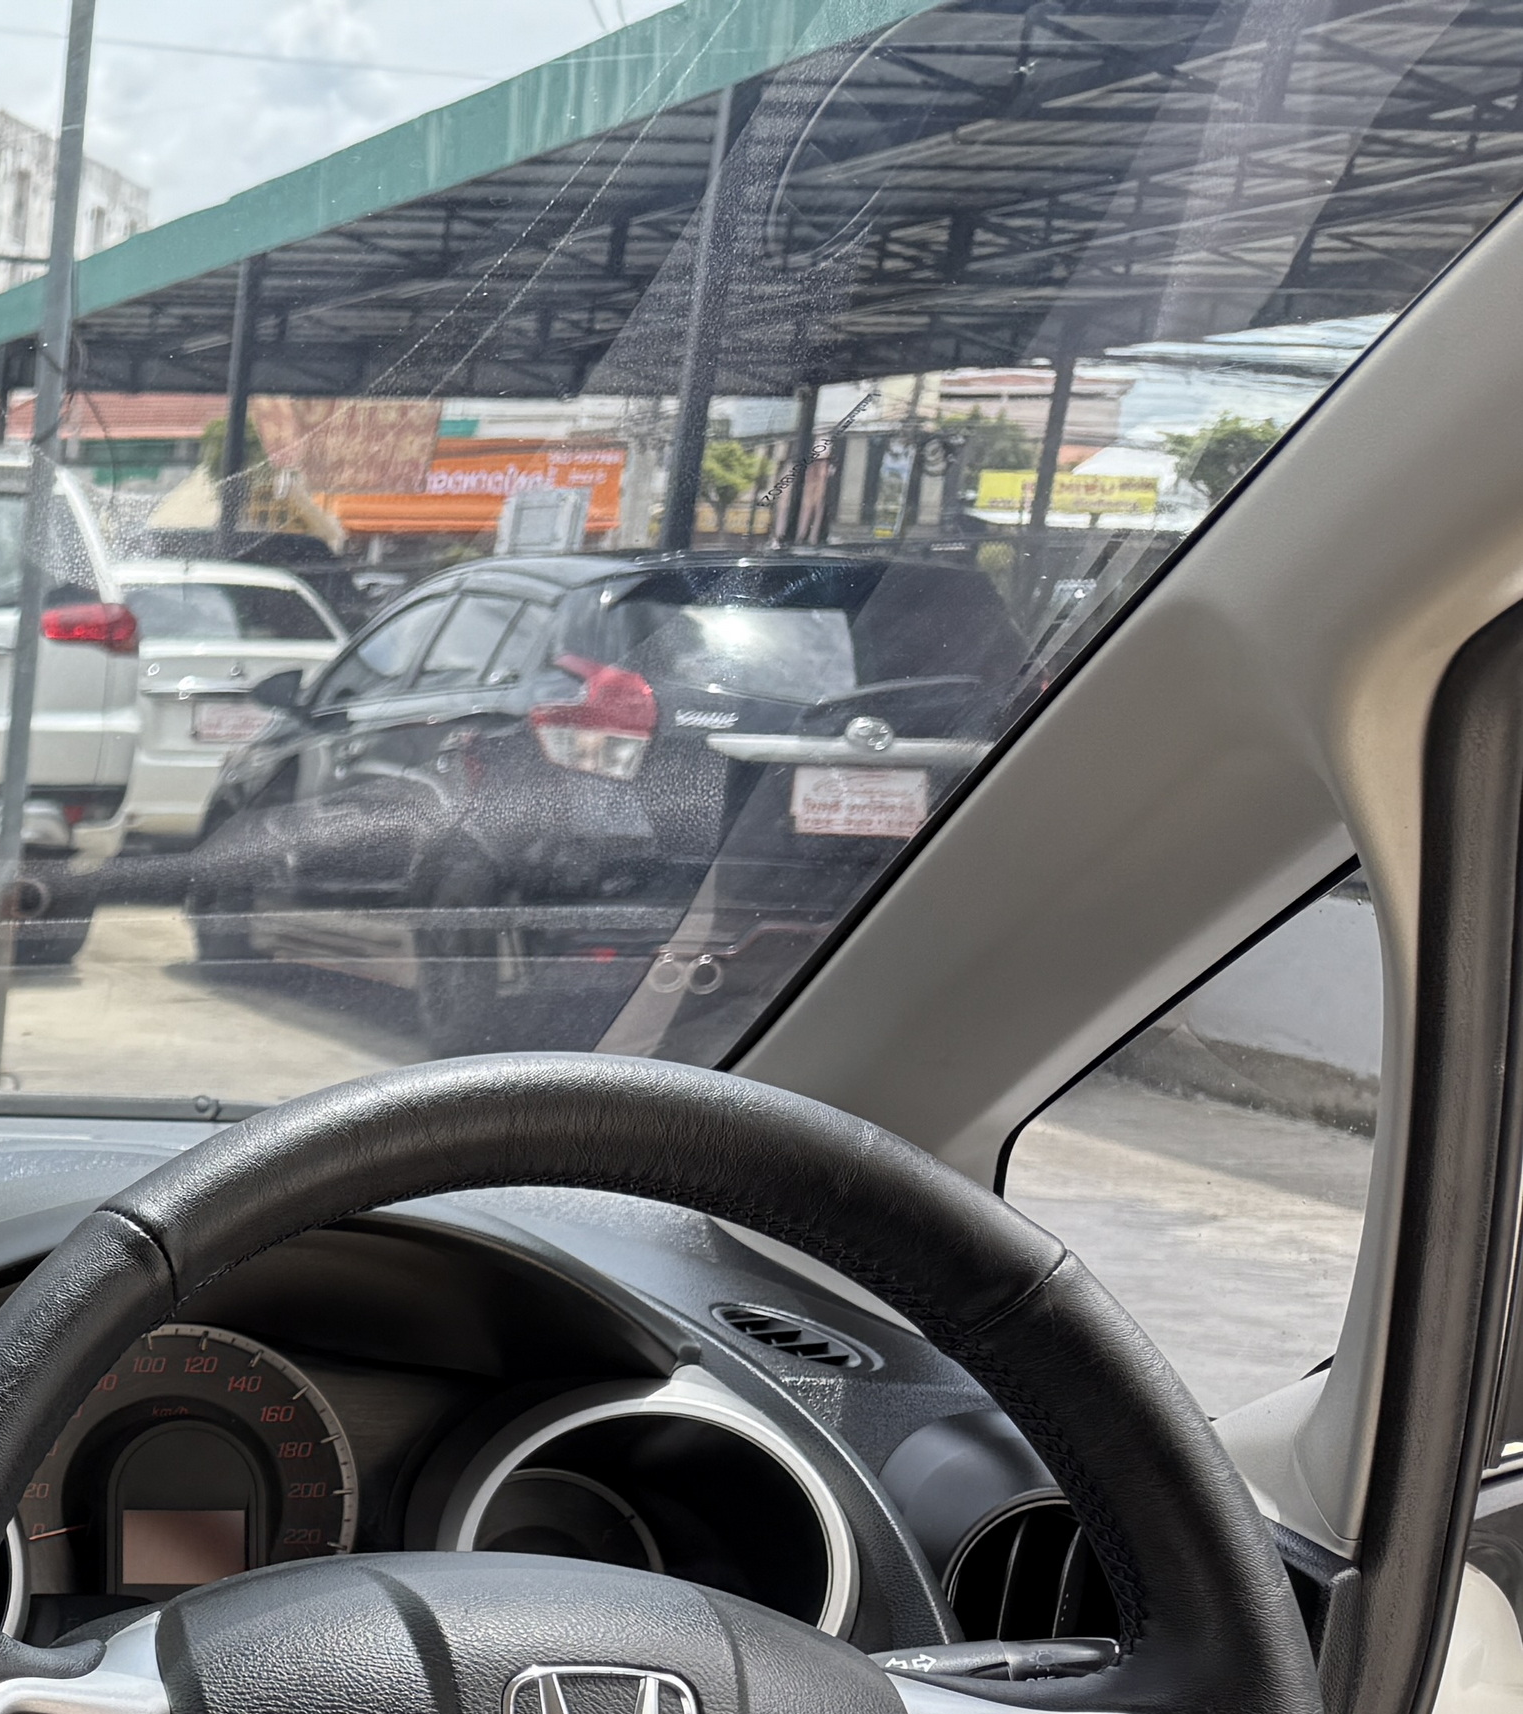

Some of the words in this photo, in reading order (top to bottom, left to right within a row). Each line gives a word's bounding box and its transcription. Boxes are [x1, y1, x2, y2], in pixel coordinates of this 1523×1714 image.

[132, 1356, 166, 1374] 100
[184, 1356, 218, 1373] 120
[227, 1375, 262, 1393] 140
[152, 1405, 190, 1417] km/h
[260, 1405, 295, 1422] 160
[276, 1442, 313, 1459] 180
[24, 1483, 50, 1499] 20
[288, 1482, 326, 1498] 200
[283, 1528, 322, 1544] 220
